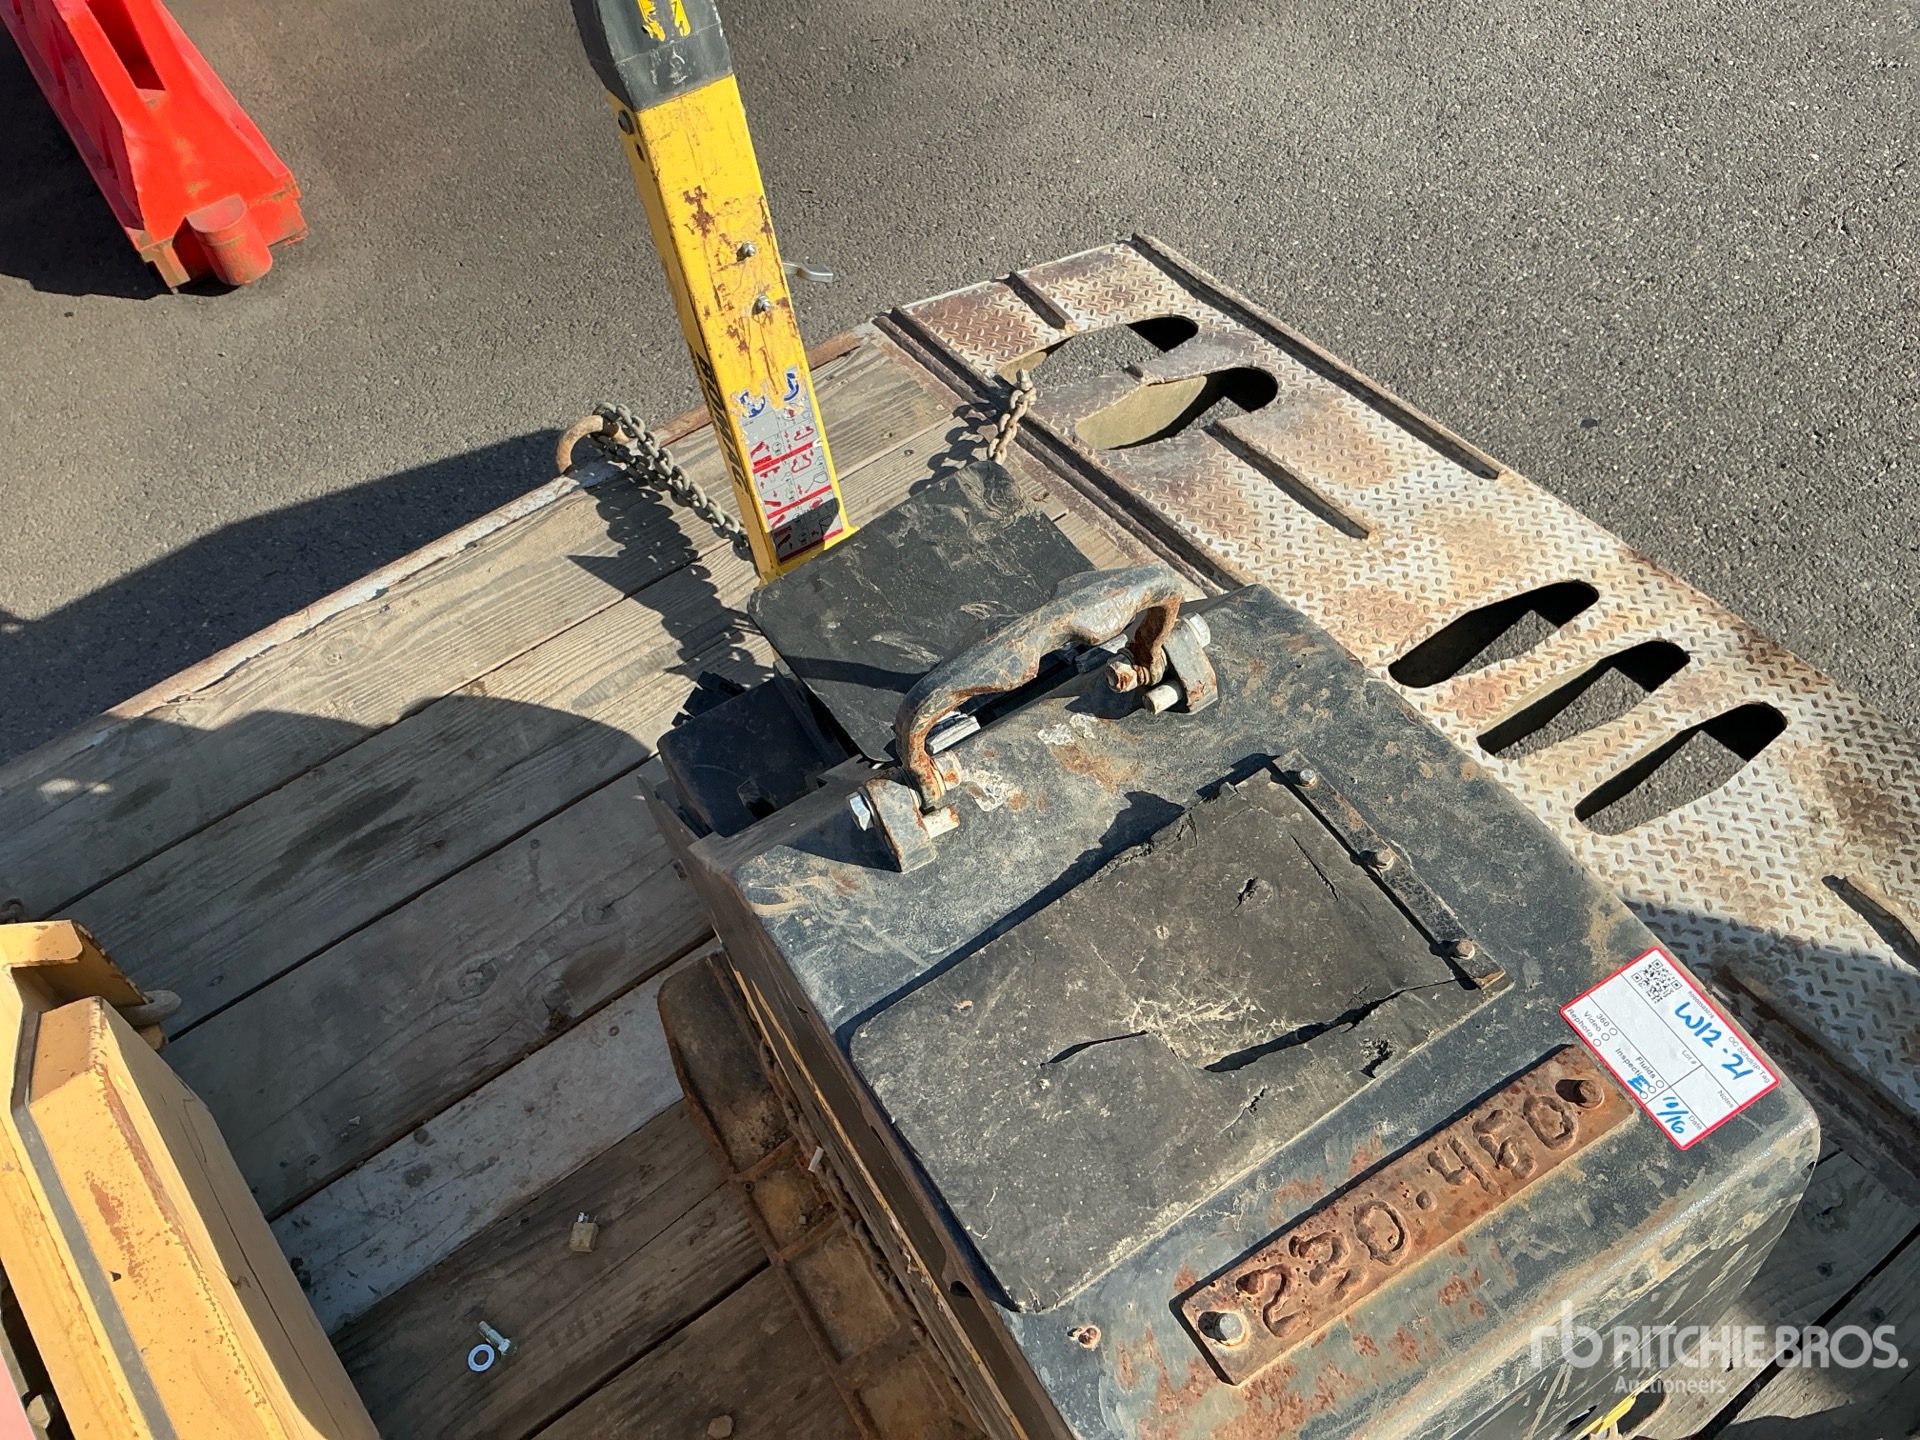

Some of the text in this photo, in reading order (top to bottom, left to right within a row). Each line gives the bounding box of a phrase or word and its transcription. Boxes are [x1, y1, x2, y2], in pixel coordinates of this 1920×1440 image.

[1567, 1008, 1593, 1038] Rephoto
[1583, 1010, 1601, 1032] Video
[1596, 1013, 1610, 1027] 360
[1682, 1049, 1693, 1061] Lot
[1728, 1036, 1740, 1048] OC
[1758, 1069, 1771, 1084] Tag
[1635, 1056, 1657, 1080] Fluids
[1717, 1089, 1734, 1109] Notes
[1688, 1115, 1703, 1131] Date
